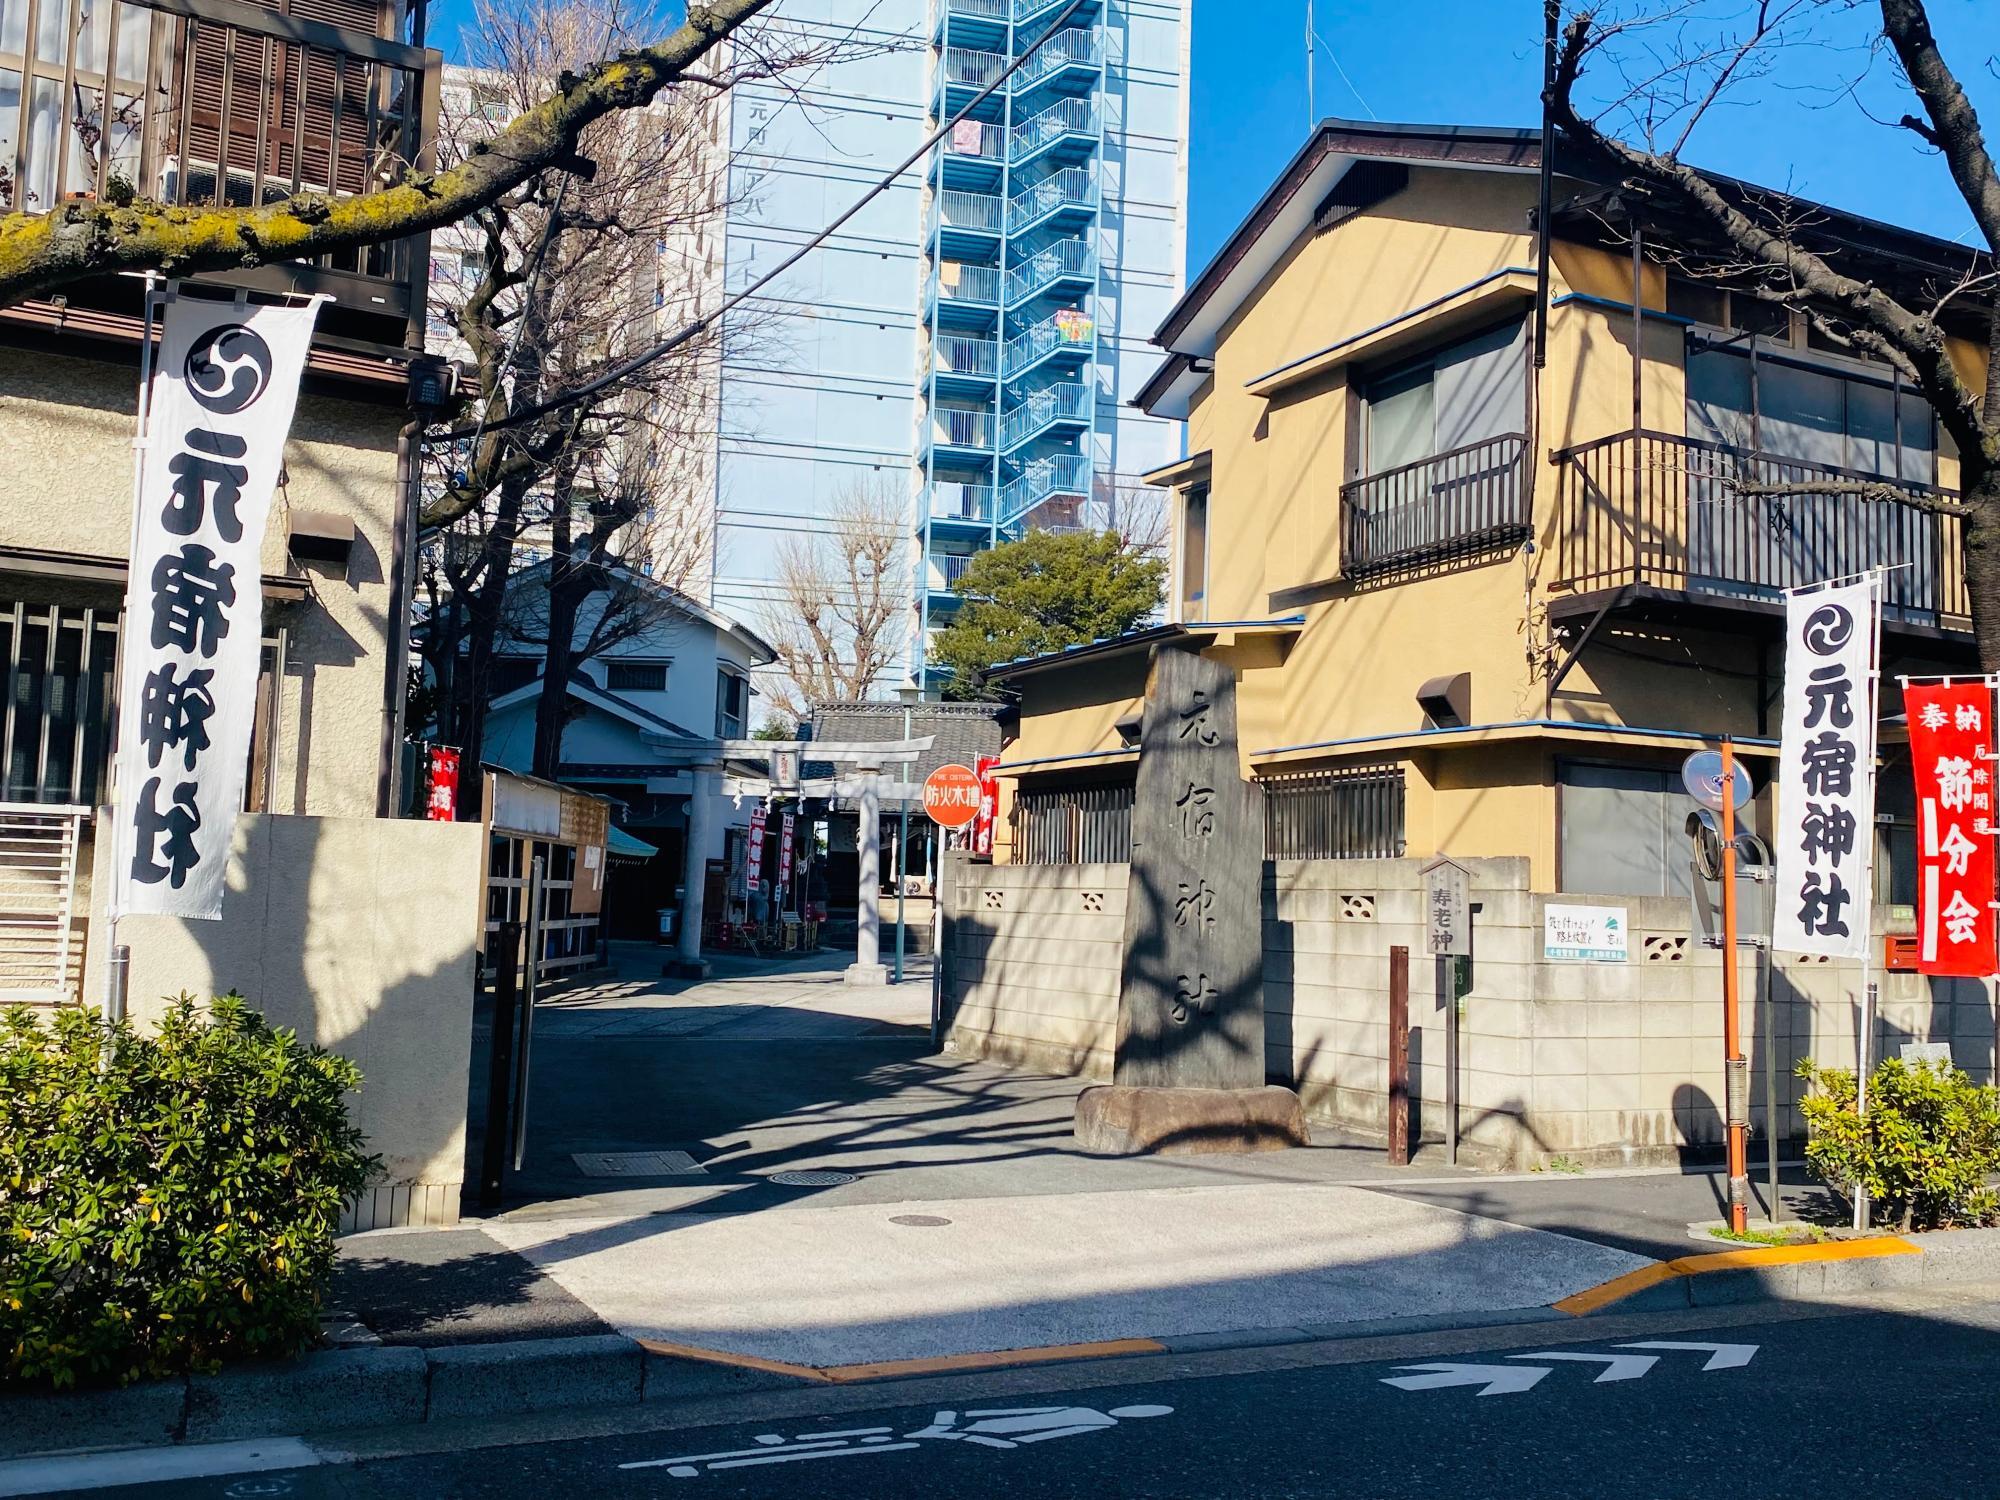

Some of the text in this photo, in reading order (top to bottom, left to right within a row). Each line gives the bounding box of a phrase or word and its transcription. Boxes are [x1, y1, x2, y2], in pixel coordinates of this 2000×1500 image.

[744, 101, 768, 286] 元町アパート
[1918, 702, 1982, 733] 奉納
[1797, 662, 1856, 938] 元宿神社
[1934, 755, 1980, 945] 節分会
[1973, 743, 1990, 834] 厄除開運
[1431, 889, 1454, 952] 寿老神
